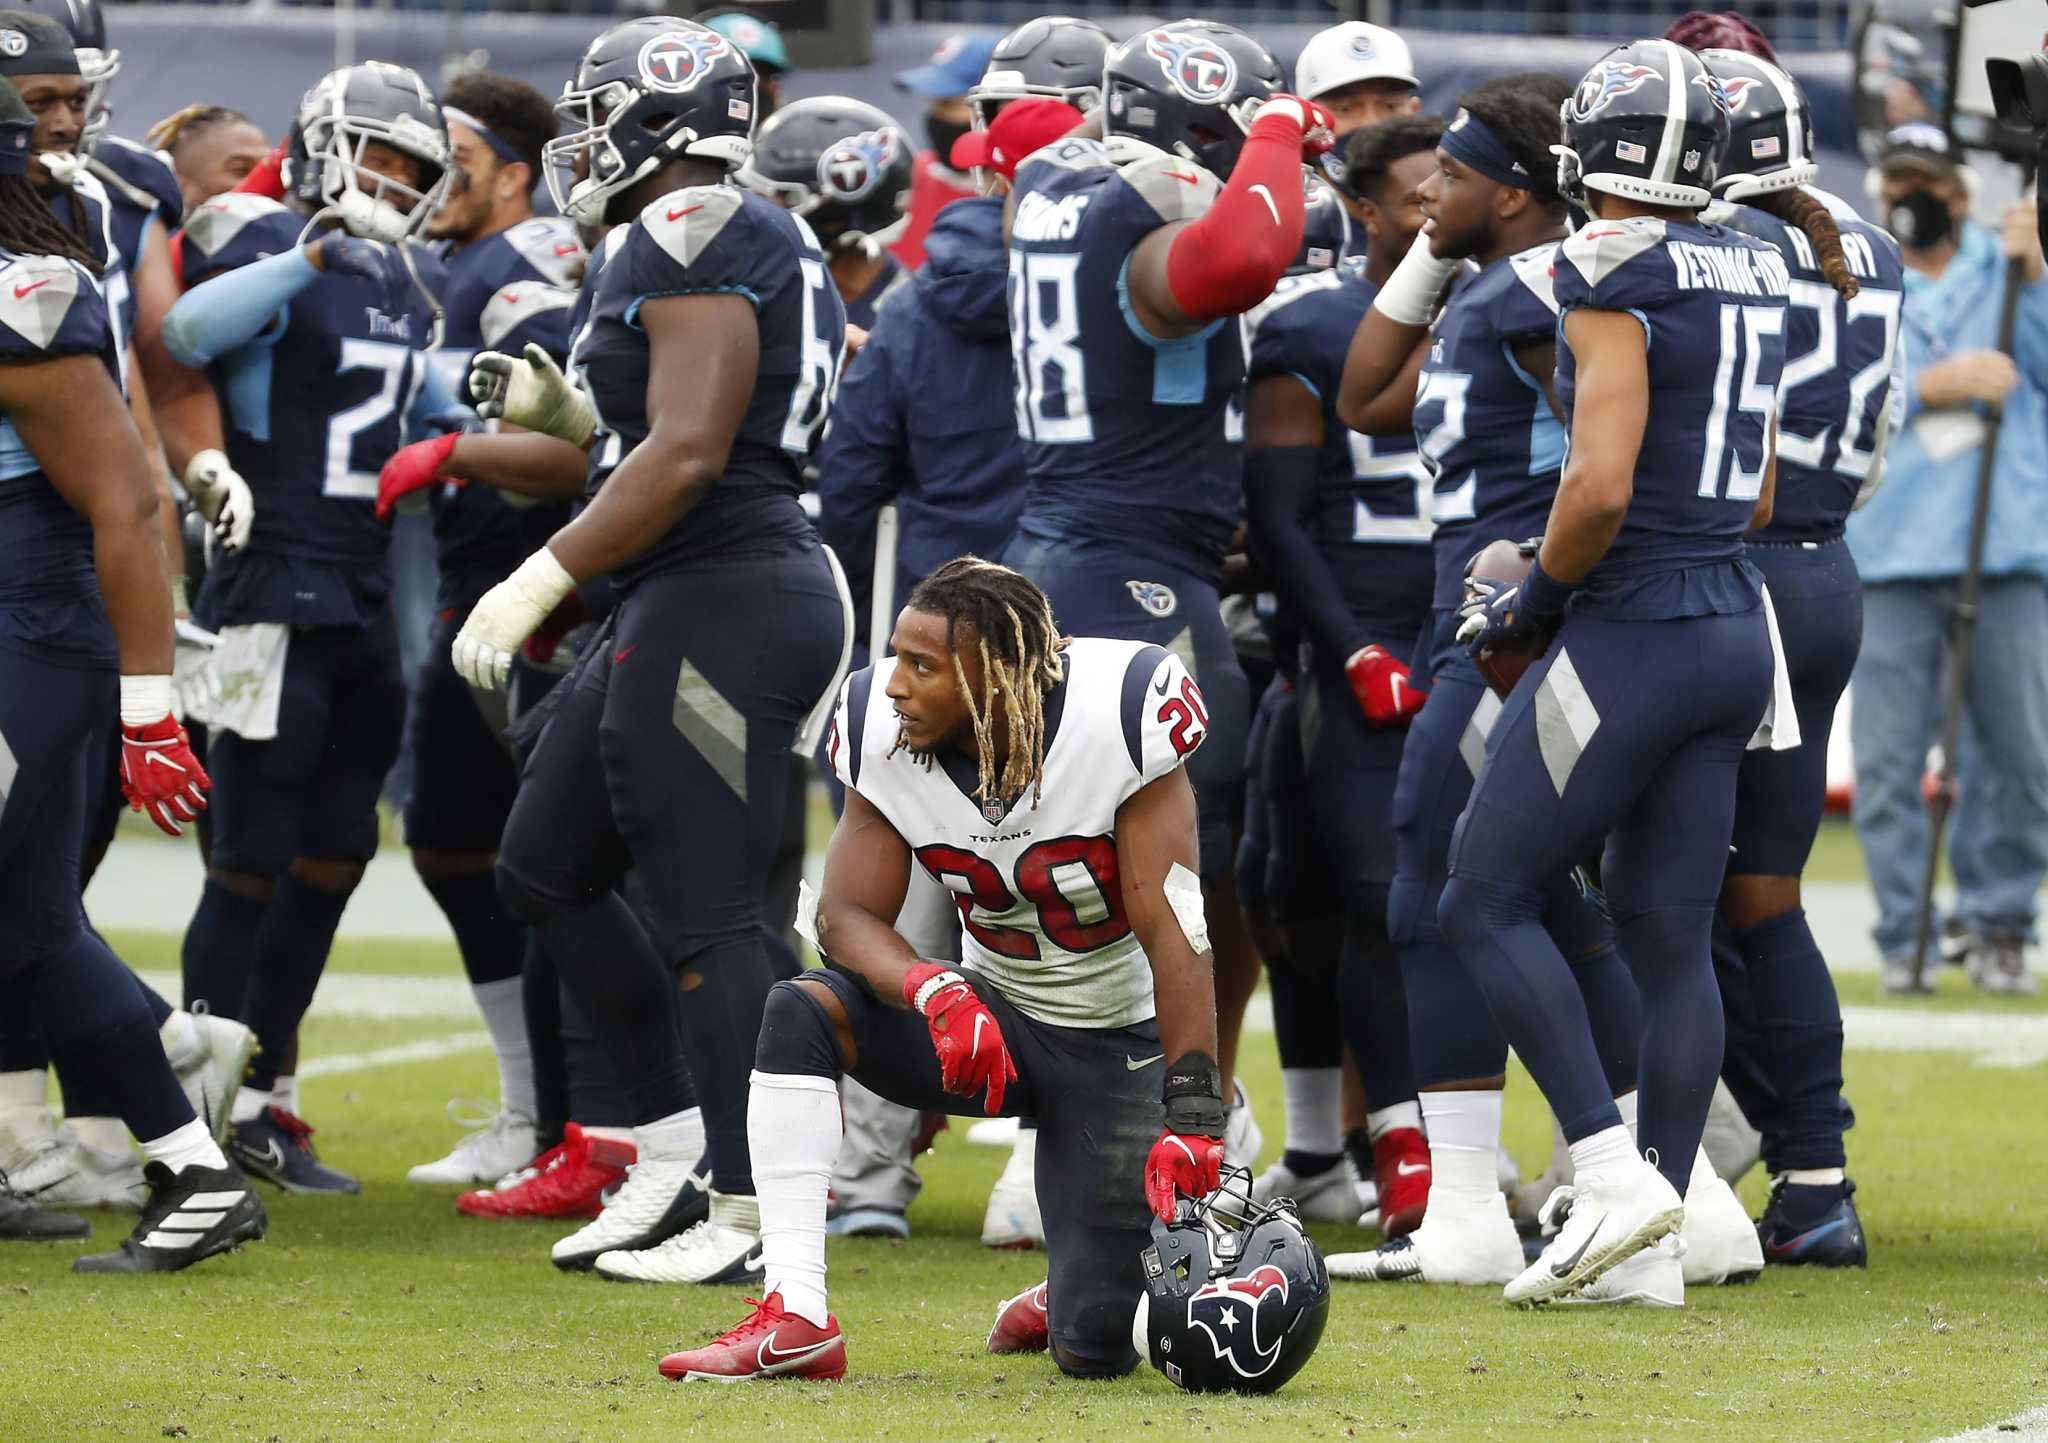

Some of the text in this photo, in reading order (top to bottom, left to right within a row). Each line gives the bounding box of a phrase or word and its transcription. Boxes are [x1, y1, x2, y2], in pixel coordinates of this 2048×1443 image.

[1612, 181, 1697, 203] TENNESSEE
[1782, 224, 1879, 279] HRY
[780, 256, 848, 453] 6
[1698, 302, 1786, 500] 15
[1775, 277, 1901, 478] 22
[1157, 675, 1209, 760] 20
[968, 828, 1032, 843] TEXANS
[911, 833, 1133, 962] 20
